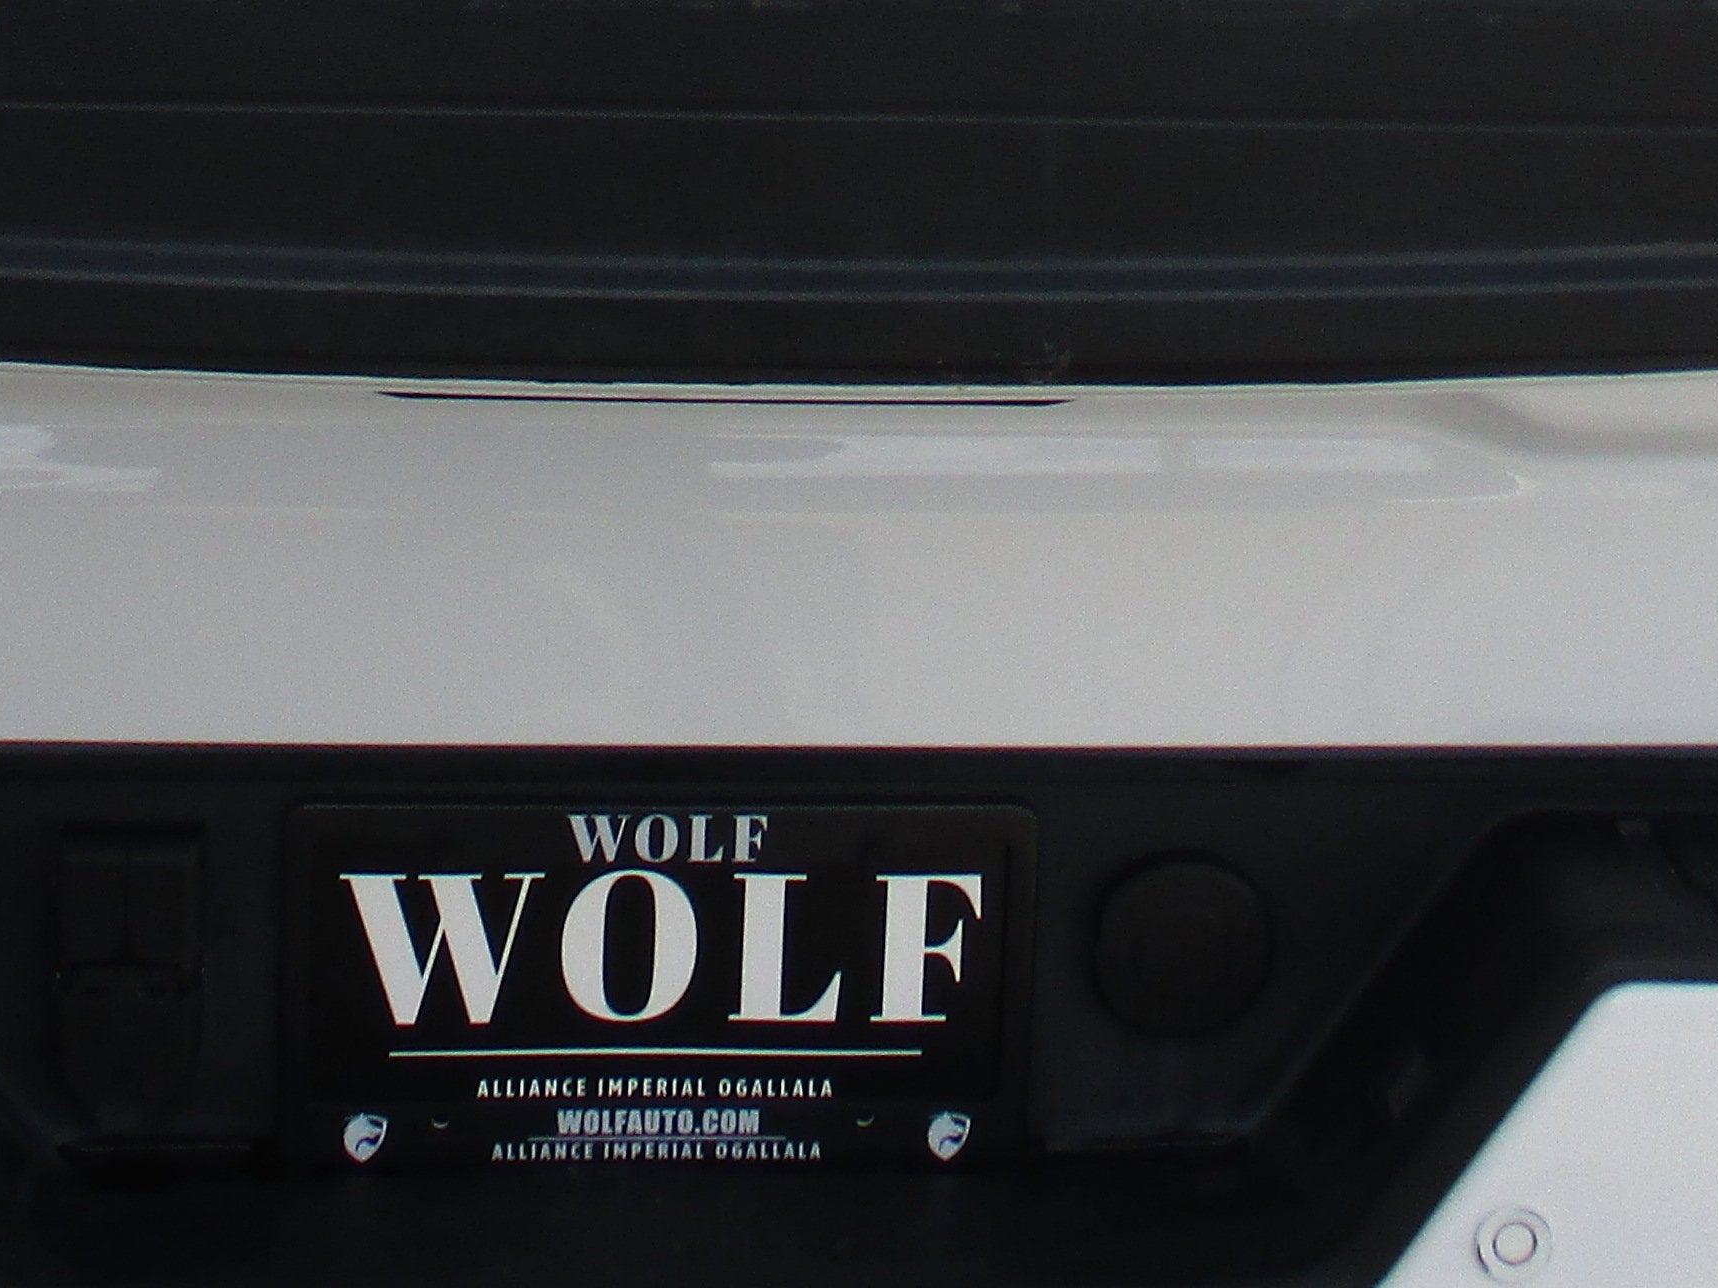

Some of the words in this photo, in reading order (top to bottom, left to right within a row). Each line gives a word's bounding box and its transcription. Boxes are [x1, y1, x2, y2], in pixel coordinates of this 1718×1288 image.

[567, 813, 768, 864] WOLF
[339, 869, 983, 1026] WOLF
[477, 1078, 587, 1099] ALLIANCE
[597, 1077, 706, 1098] IMPERIAL
[718, 1077, 833, 1099] OGALLALA
[556, 1108, 760, 1136] WOLFAUTO.COM
[491, 1141, 594, 1161] ALLIANCE
[603, 1141, 705, 1161] IMPERIAL
[715, 1141, 822, 1161] OGALLALA
